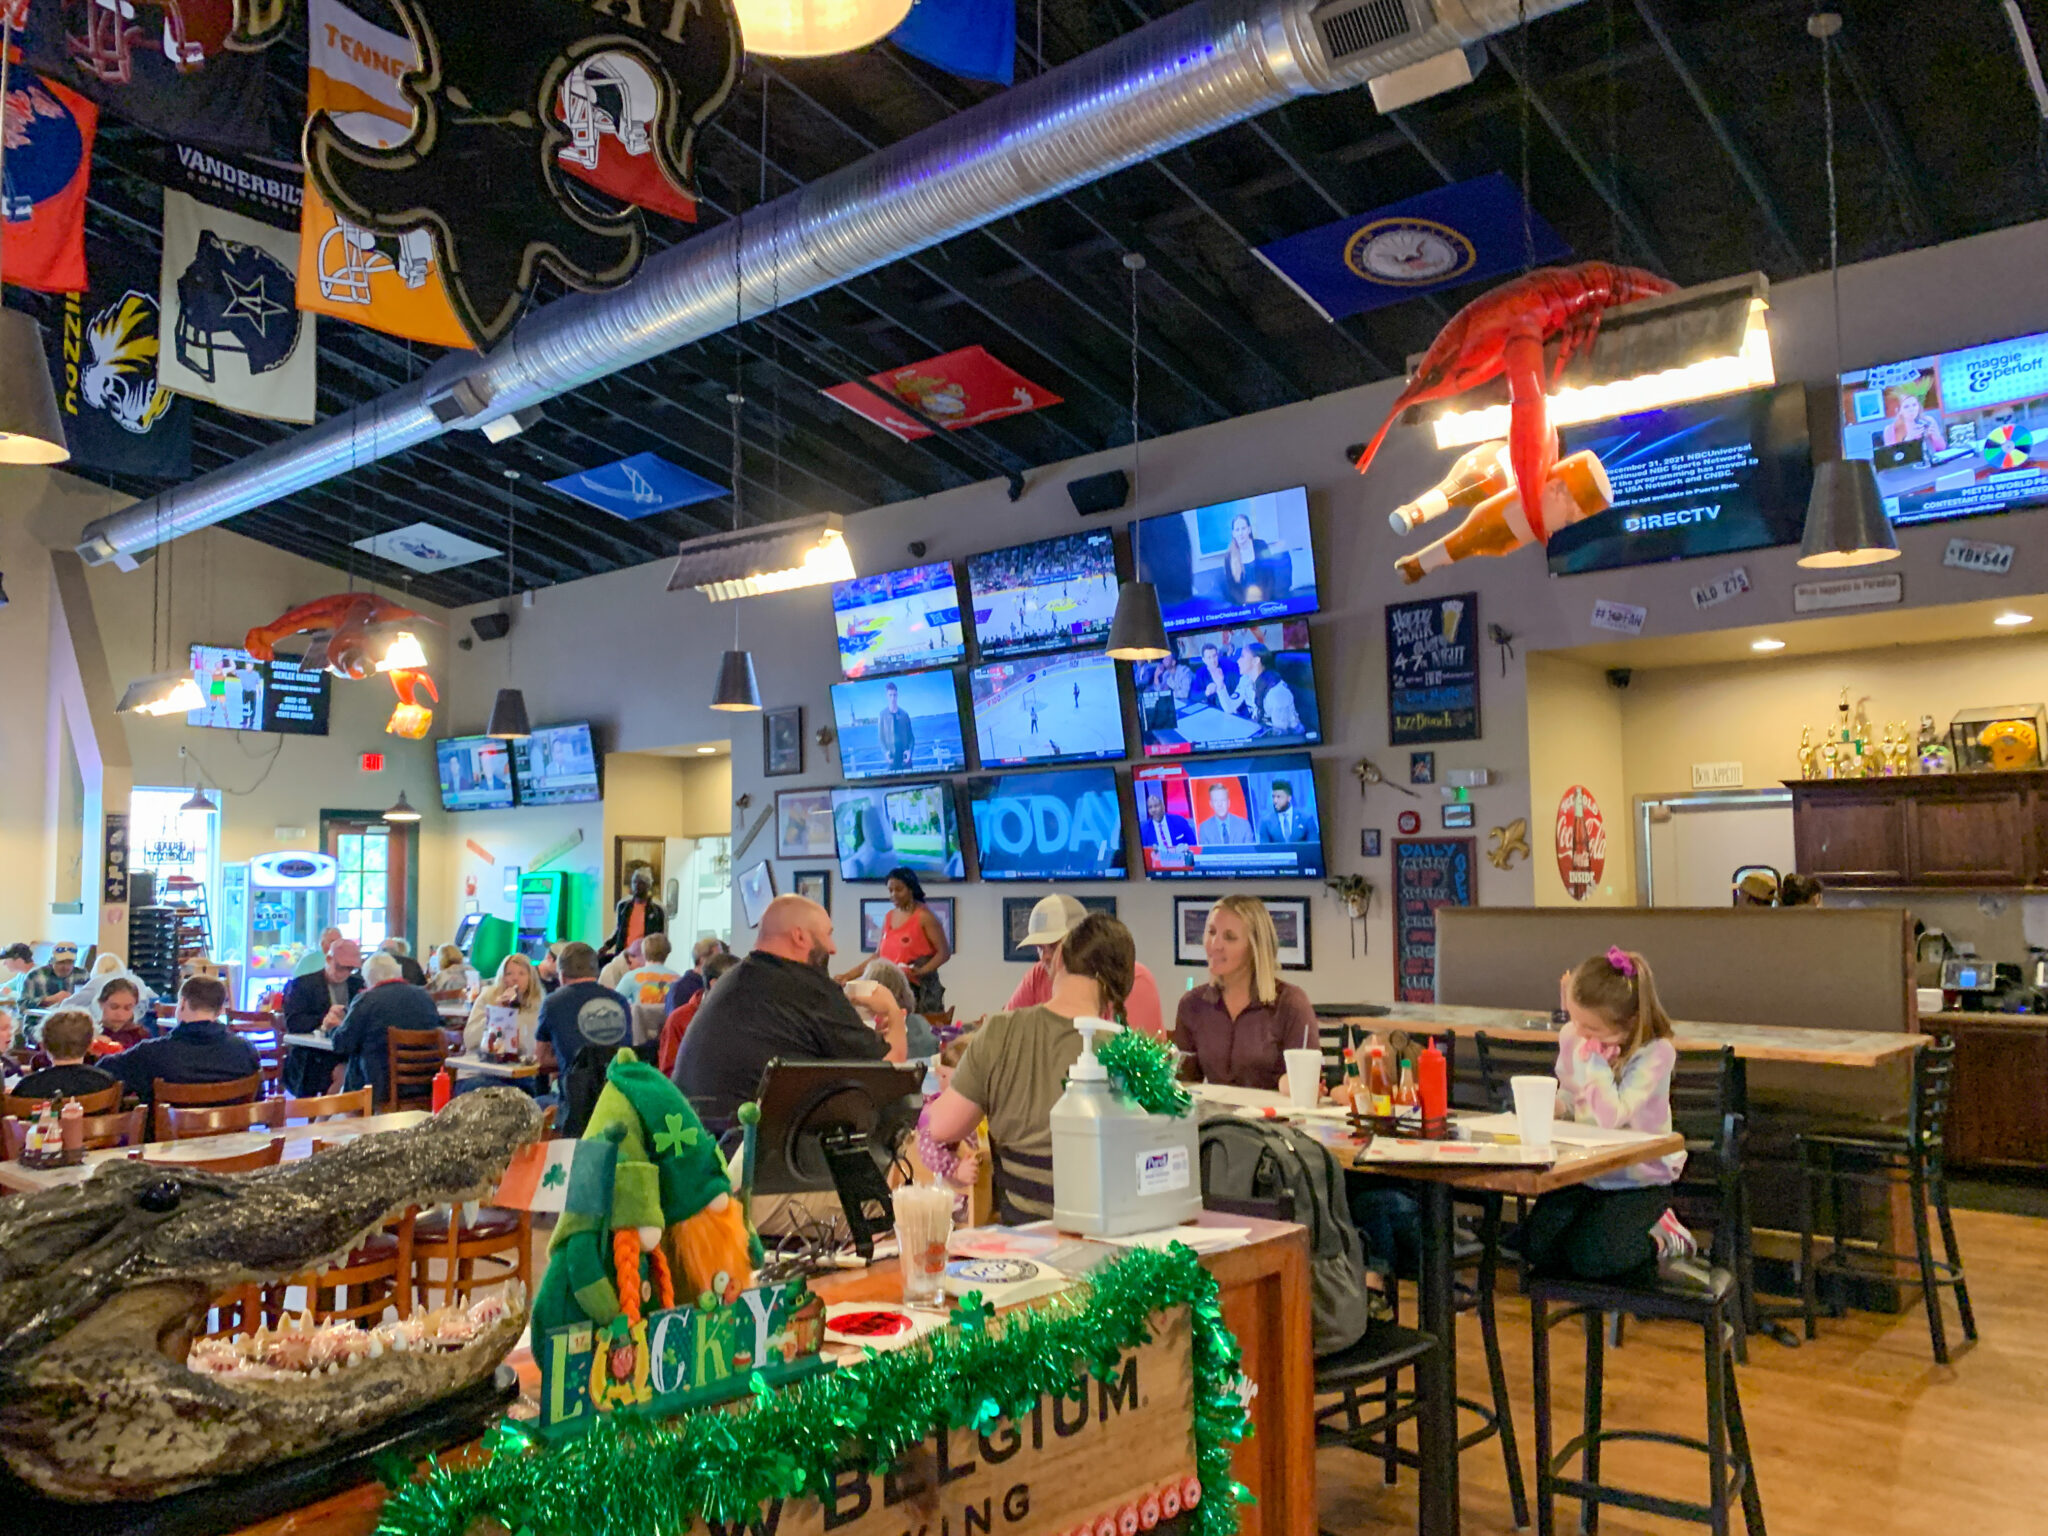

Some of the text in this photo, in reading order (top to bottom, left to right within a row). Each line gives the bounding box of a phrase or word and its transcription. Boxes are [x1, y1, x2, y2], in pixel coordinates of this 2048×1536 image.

[324, 23, 417, 79] TENNE
[1967, 352, 2022, 371] maggie
[1969, 357, 2043, 393] & perloff
[1664, 456, 1685, 466] 2021
[1687, 443, 1753, 462] NBCUniversal
[1635, 469, 1696, 485] programming
[1697, 466, 1713, 475] has
[1716, 460, 1746, 471] moved
[1650, 466, 1670, 475] NBC
[1671, 461, 1701, 473] Sports
[1612, 487, 1623, 496] he
[1625, 484, 1643, 494] USA
[1645, 477, 1683, 490] Network
[1685, 475, 1702, 484] and
[1996, 479, 2033, 492] WORLD
[1625, 505, 1721, 532] DIRECTV
[362, 754, 384, 771] EXIT
[972, 790, 1121, 855] TODAY
[1400, 844, 1456, 857] DAILY
[551, 1284, 787, 1424] LUCKY
